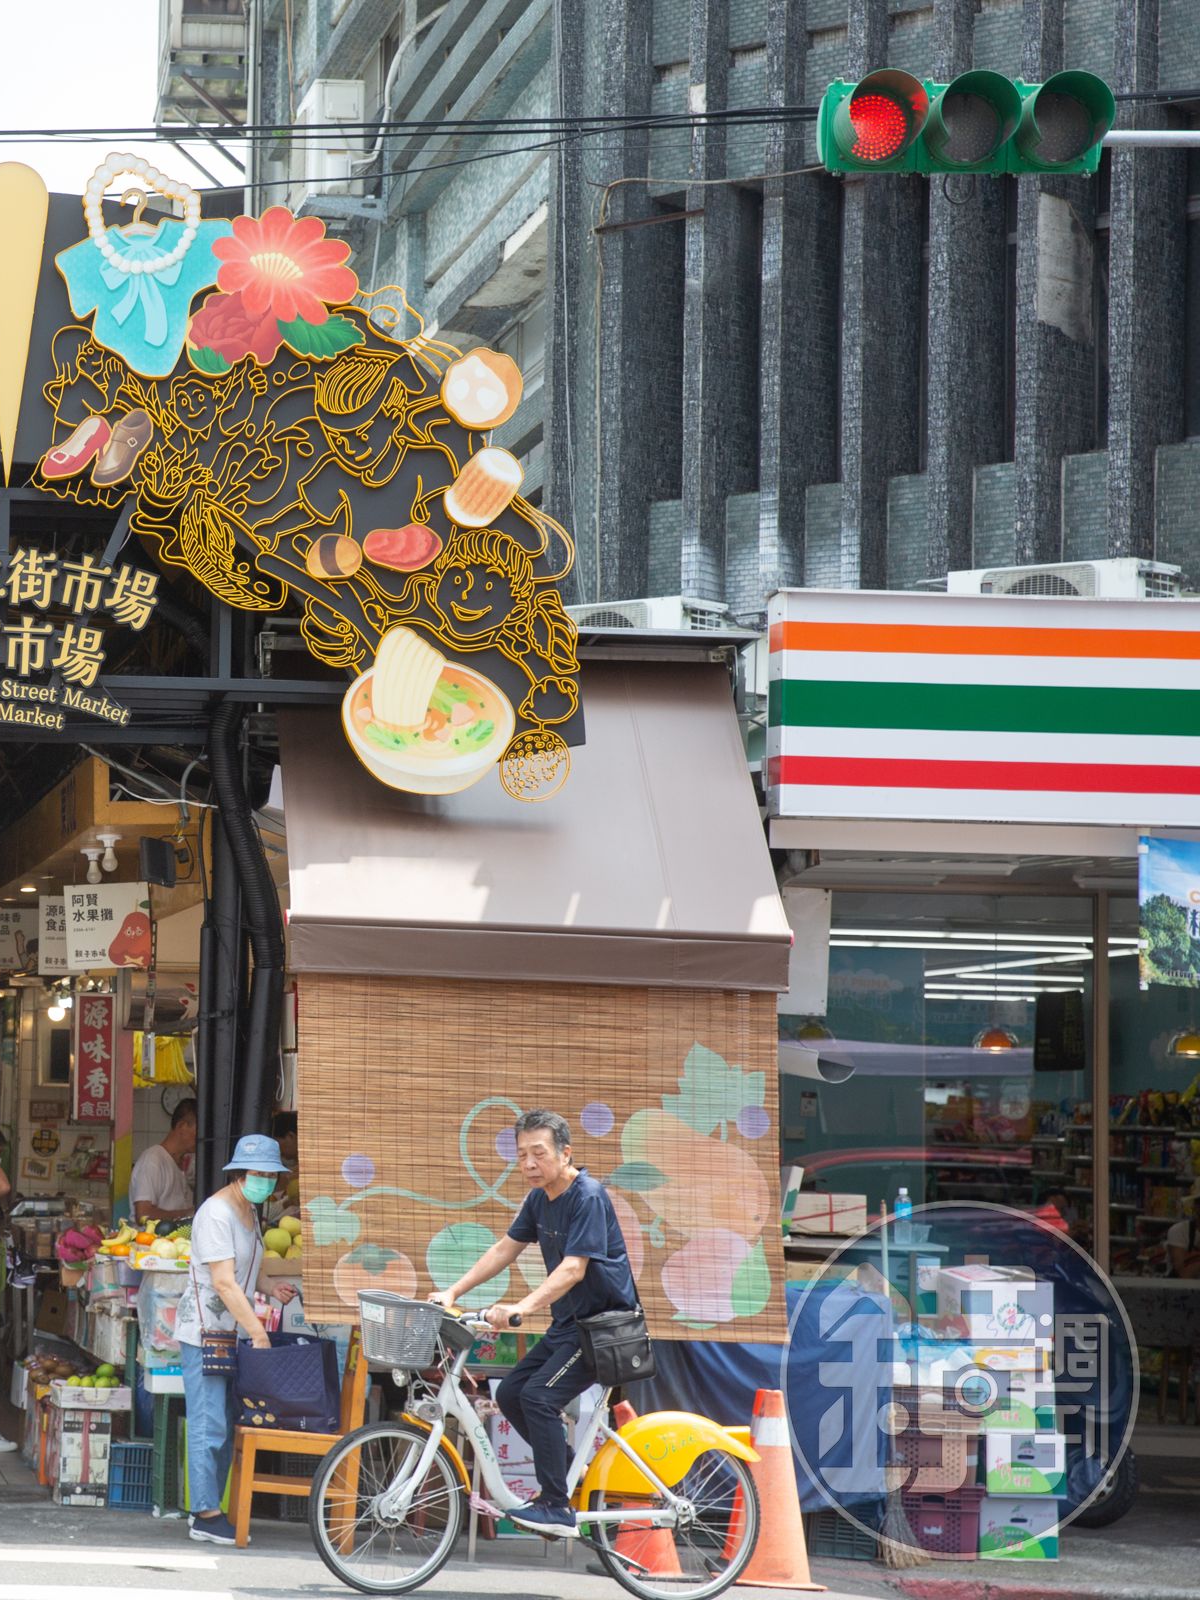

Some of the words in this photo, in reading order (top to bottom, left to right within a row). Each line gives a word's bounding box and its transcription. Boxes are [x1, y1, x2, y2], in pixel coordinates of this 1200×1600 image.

[1, 679, 57, 703] Street
[62, 687, 129, 724] Market
[71, 893, 98, 907] 阿賢
[72, 908, 114, 923] 水果攤
[82, 1000, 111, 1099] 源味香
[80, 1101, 111, 1117] 食品
